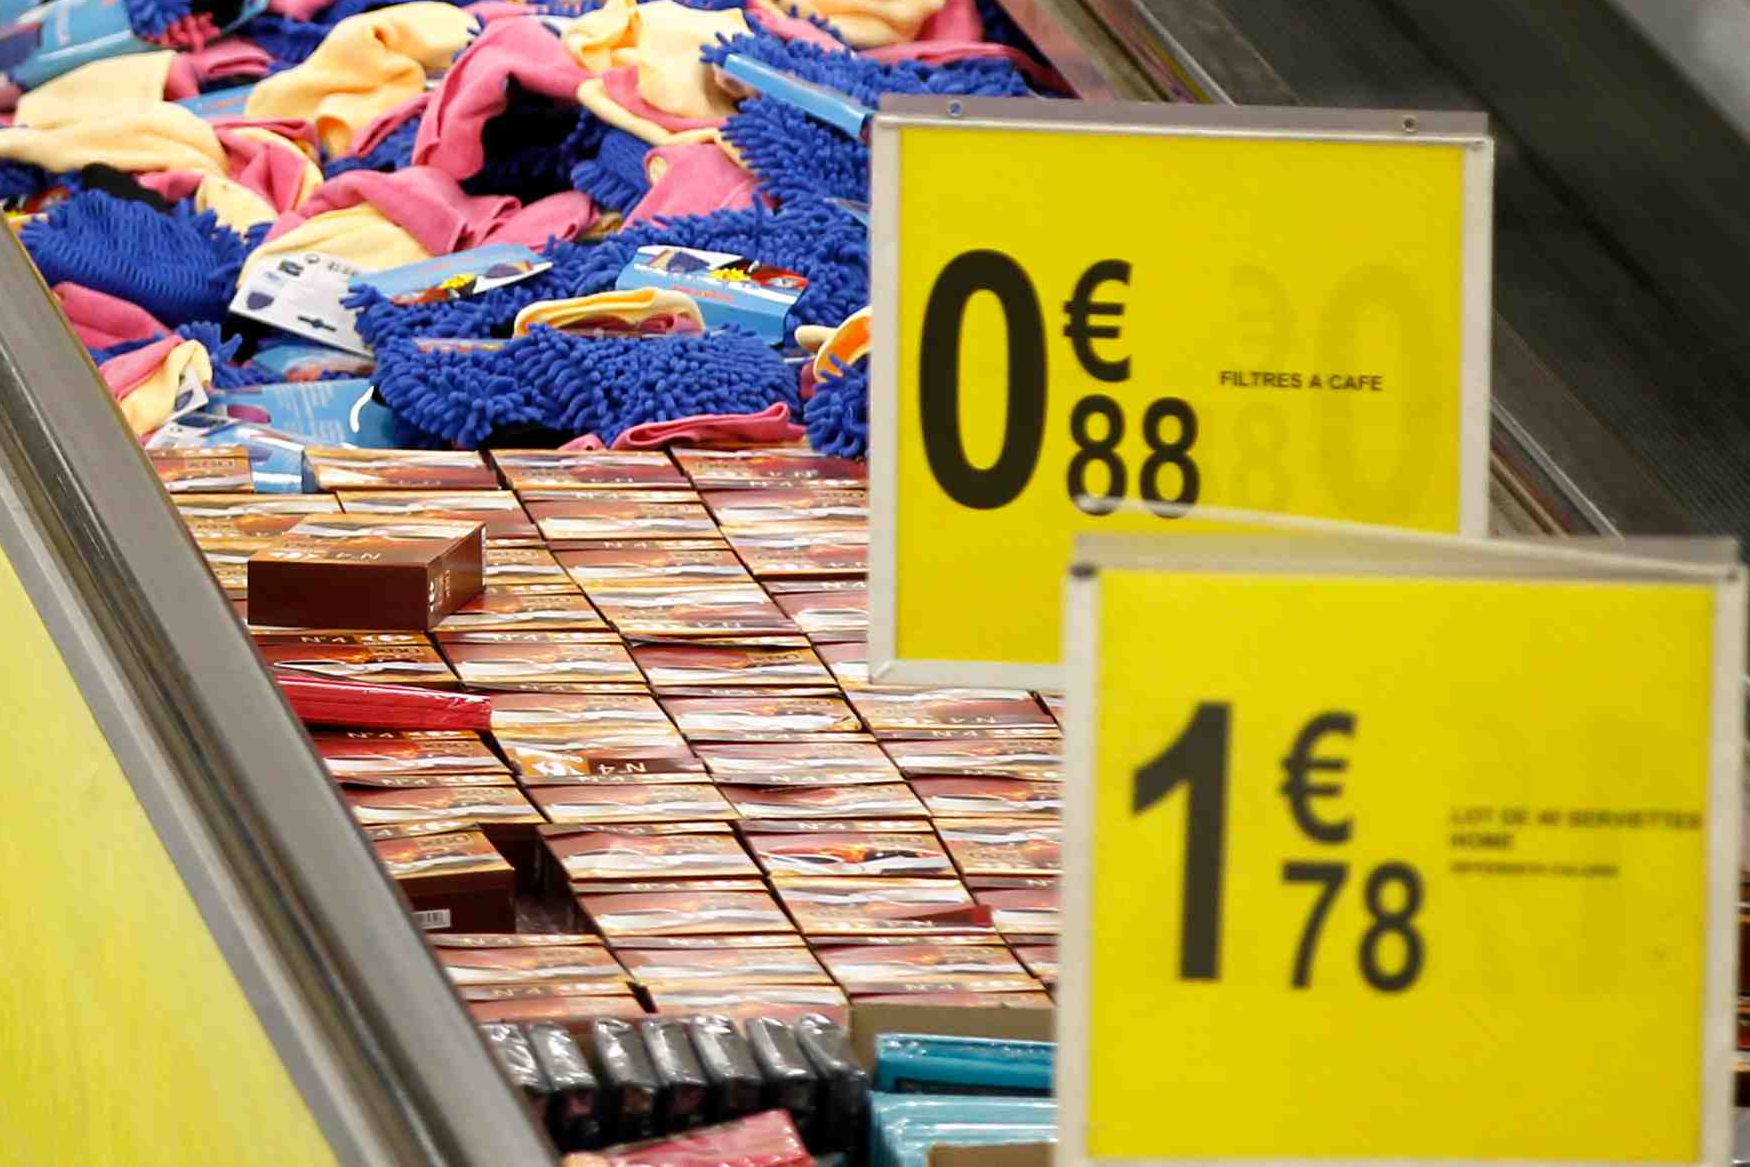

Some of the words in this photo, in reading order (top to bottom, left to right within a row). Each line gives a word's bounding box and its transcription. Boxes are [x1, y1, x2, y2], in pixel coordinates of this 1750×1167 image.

[918, 249, 1048, 511] 0
[1063, 259, 1132, 383] €
[1219, 370, 1302, 388] FILTRES
[1308, 373, 1323, 389] A
[1327, 374, 1383, 392] CAFE
[1066, 394, 1201, 520] 88
[1132, 702, 1231, 981] 1
[1280, 711, 1356, 845] €
[1282, 861, 1425, 994] 78
